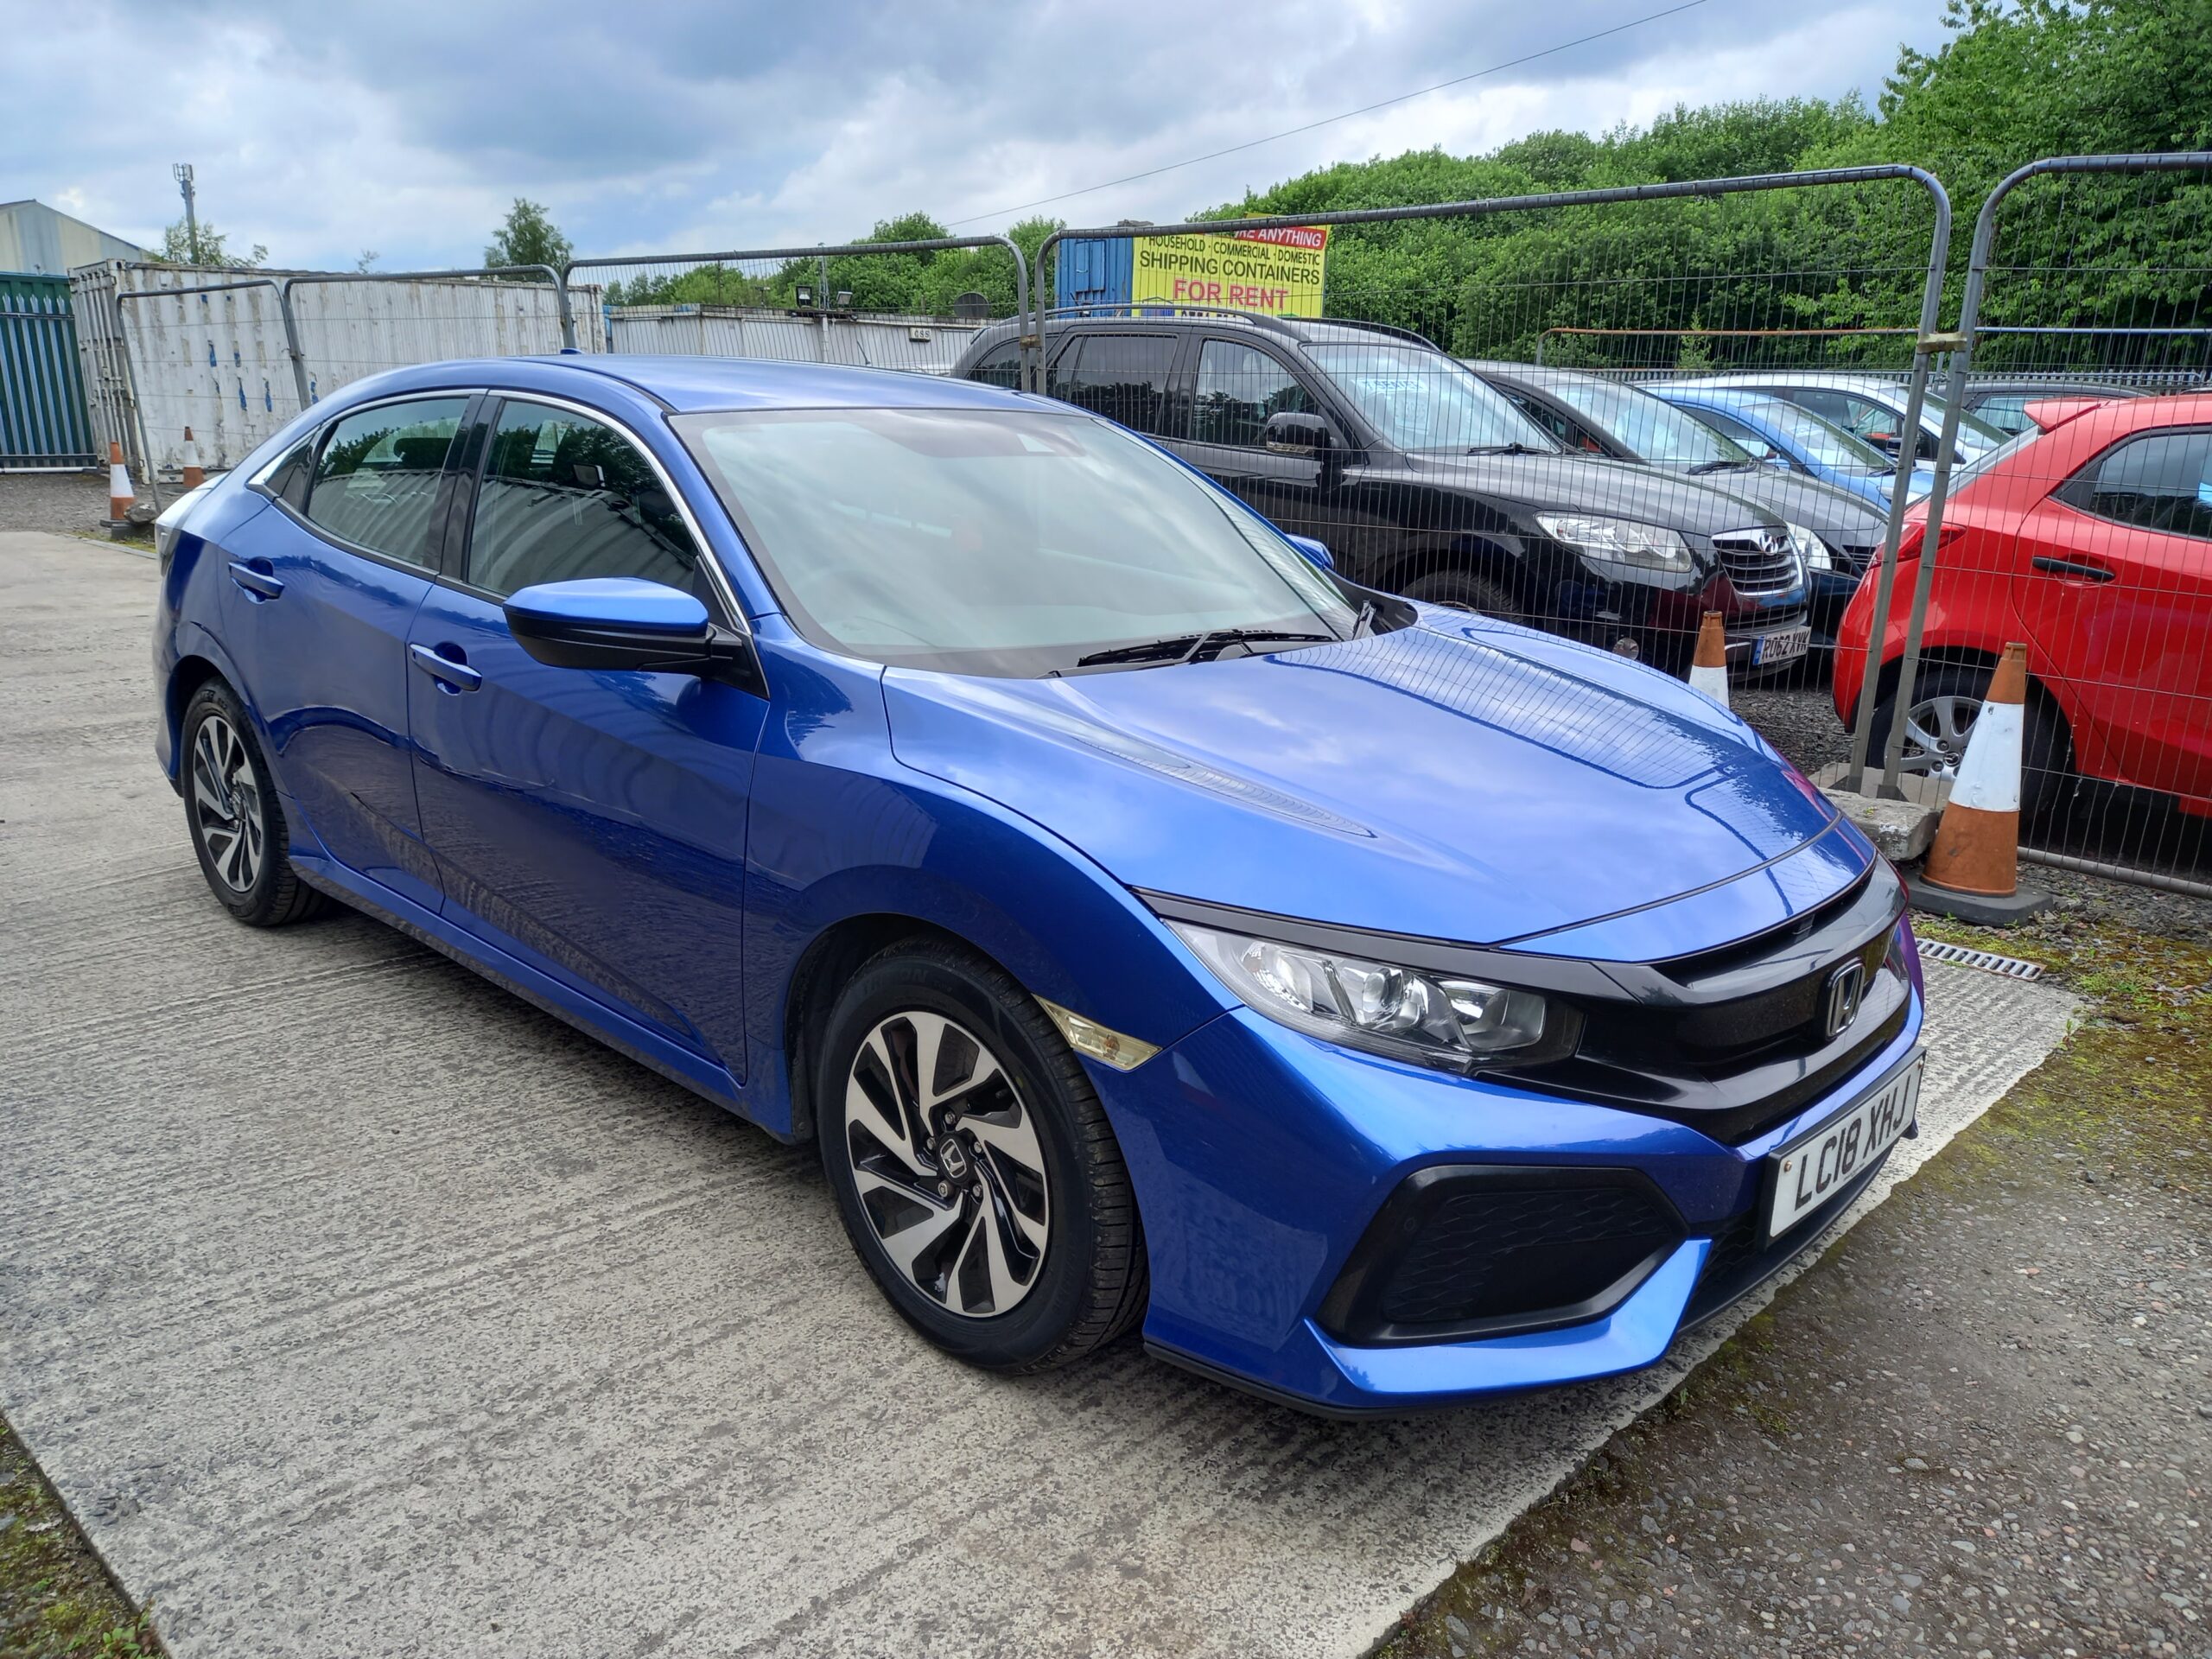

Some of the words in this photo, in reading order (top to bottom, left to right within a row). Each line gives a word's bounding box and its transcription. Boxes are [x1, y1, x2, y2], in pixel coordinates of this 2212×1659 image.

[1148, 235, 1205, 252] HOUSEHOLD
[1213, 241, 1270, 261] COMMERCIAL
[1277, 249, 1320, 266] DOMESTIC
[1258, 226, 1322, 247] ANYTHING
[1139, 251, 1218, 275] SHIPPING
[1223, 259, 1320, 285] CONTAINERS
[1173, 278, 1222, 303] FOR
[1229, 283, 1288, 309] RENT
[1795, 1118, 1862, 1211] LC18
[1862, 1075, 1912, 1159] XHJ
